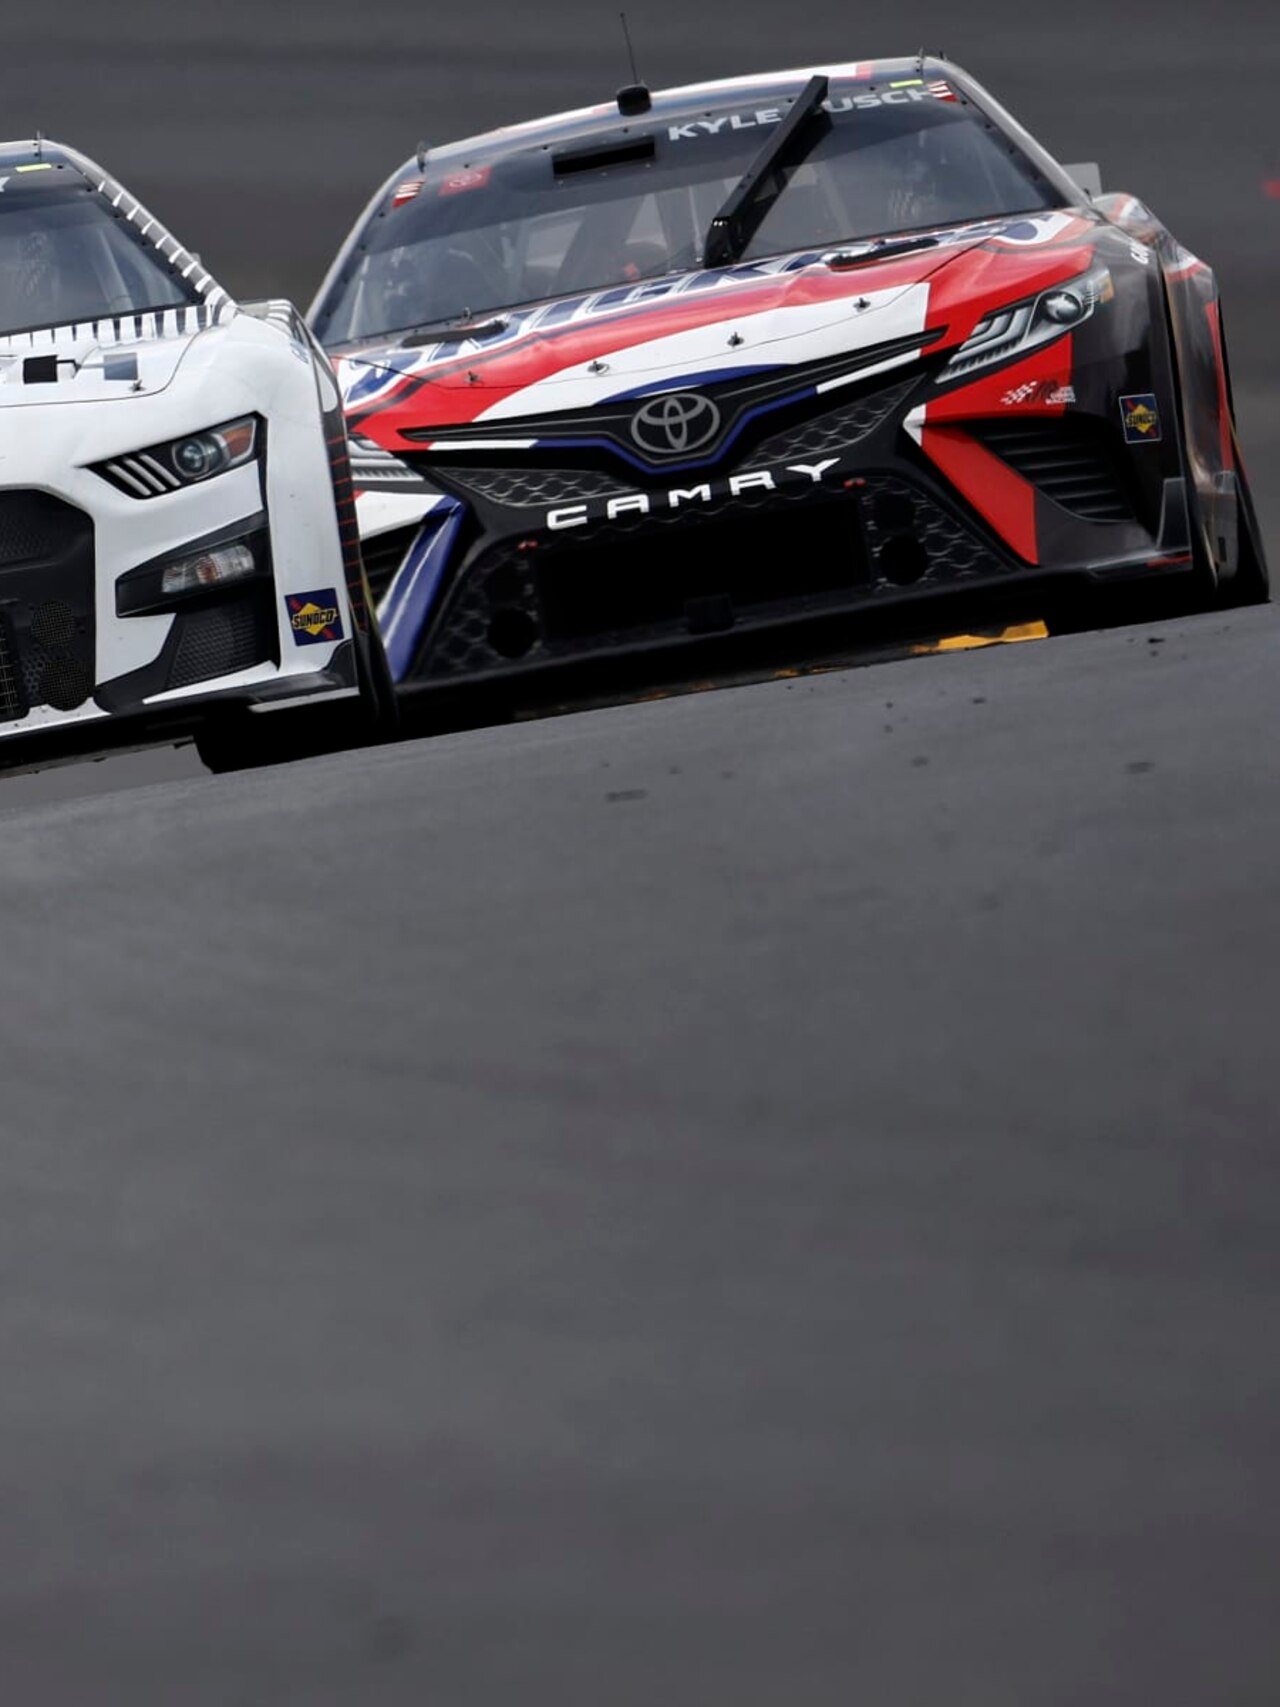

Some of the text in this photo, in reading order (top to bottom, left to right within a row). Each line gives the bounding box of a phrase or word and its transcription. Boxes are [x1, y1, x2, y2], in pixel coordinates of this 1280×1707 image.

[668, 87, 933, 141] KYLE USCH
[546, 457, 842, 531] CAMRY
[291, 607, 338, 630] SUNOCO
